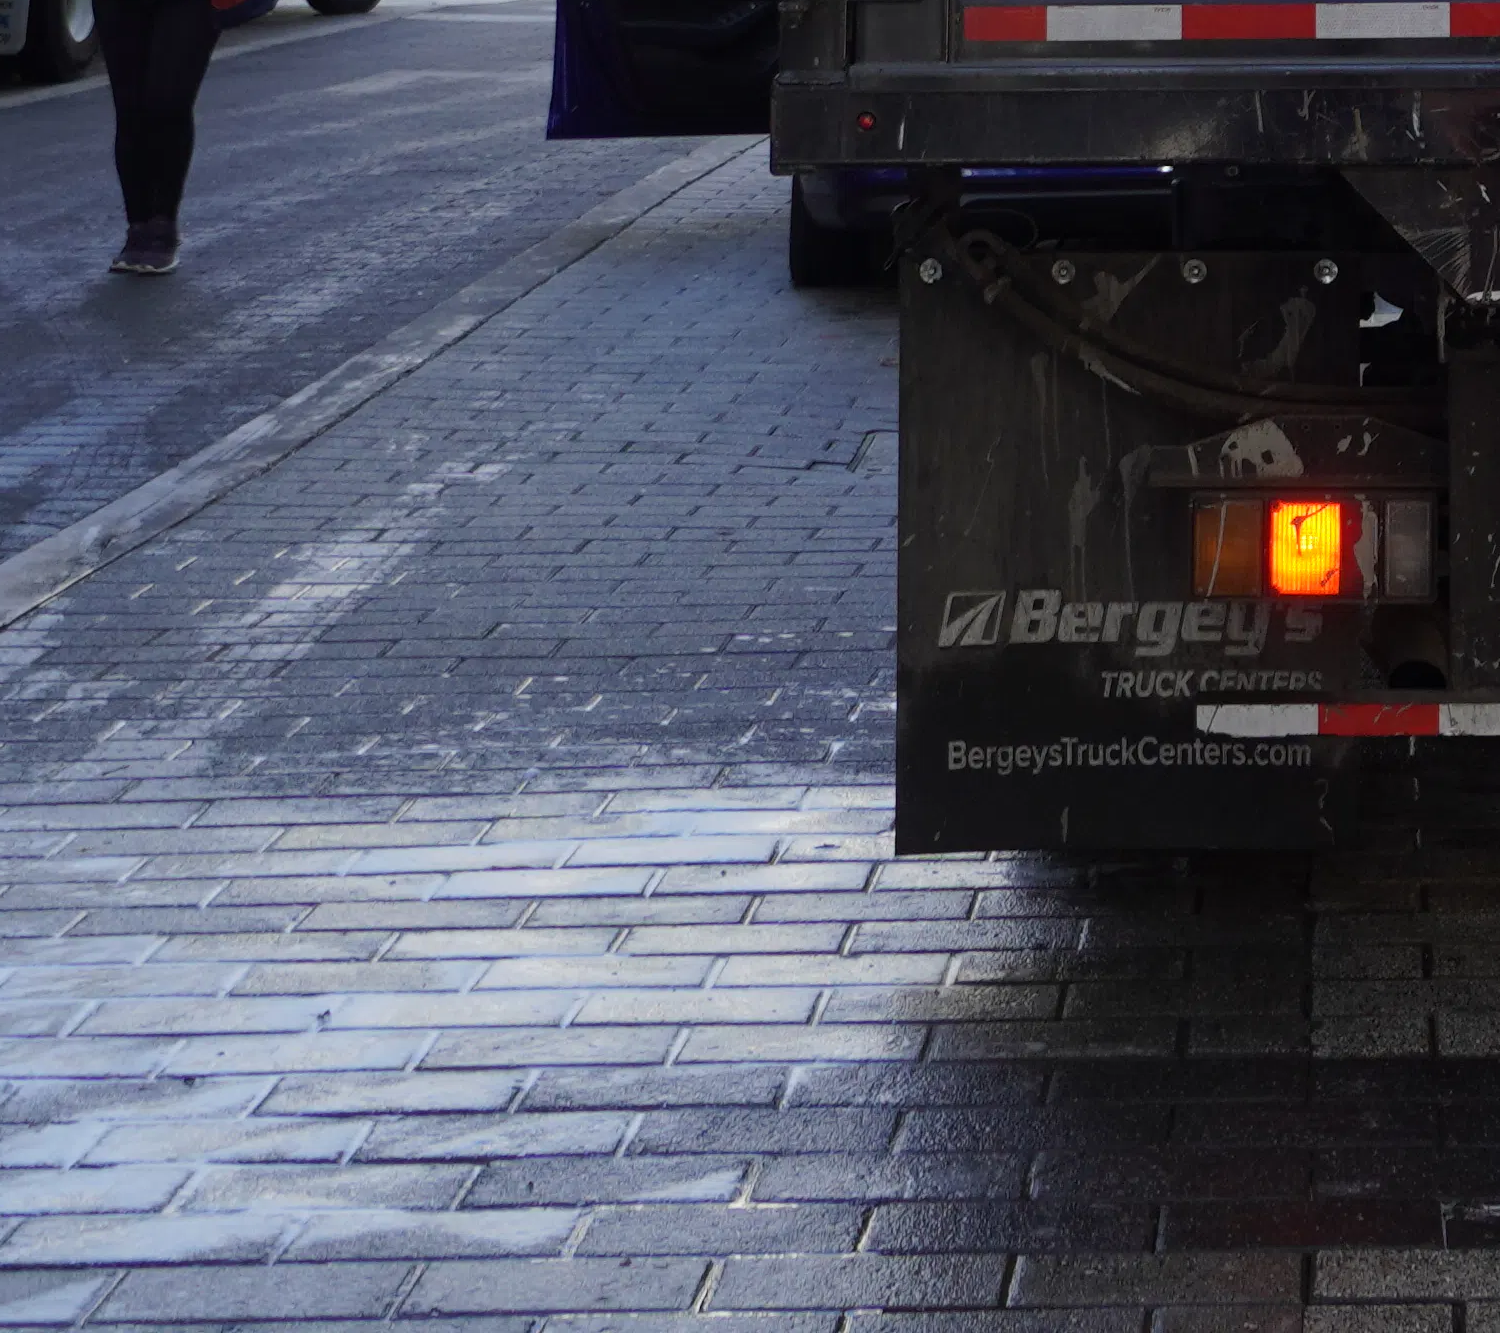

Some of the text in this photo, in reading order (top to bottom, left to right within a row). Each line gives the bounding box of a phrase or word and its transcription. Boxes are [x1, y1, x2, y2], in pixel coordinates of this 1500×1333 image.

[1008, 589, 1323, 657] Bergey's
[1101, 671, 1322, 698] TRUCK CENTERS
[948, 737, 1311, 774] BergeysTruckCenters.com
